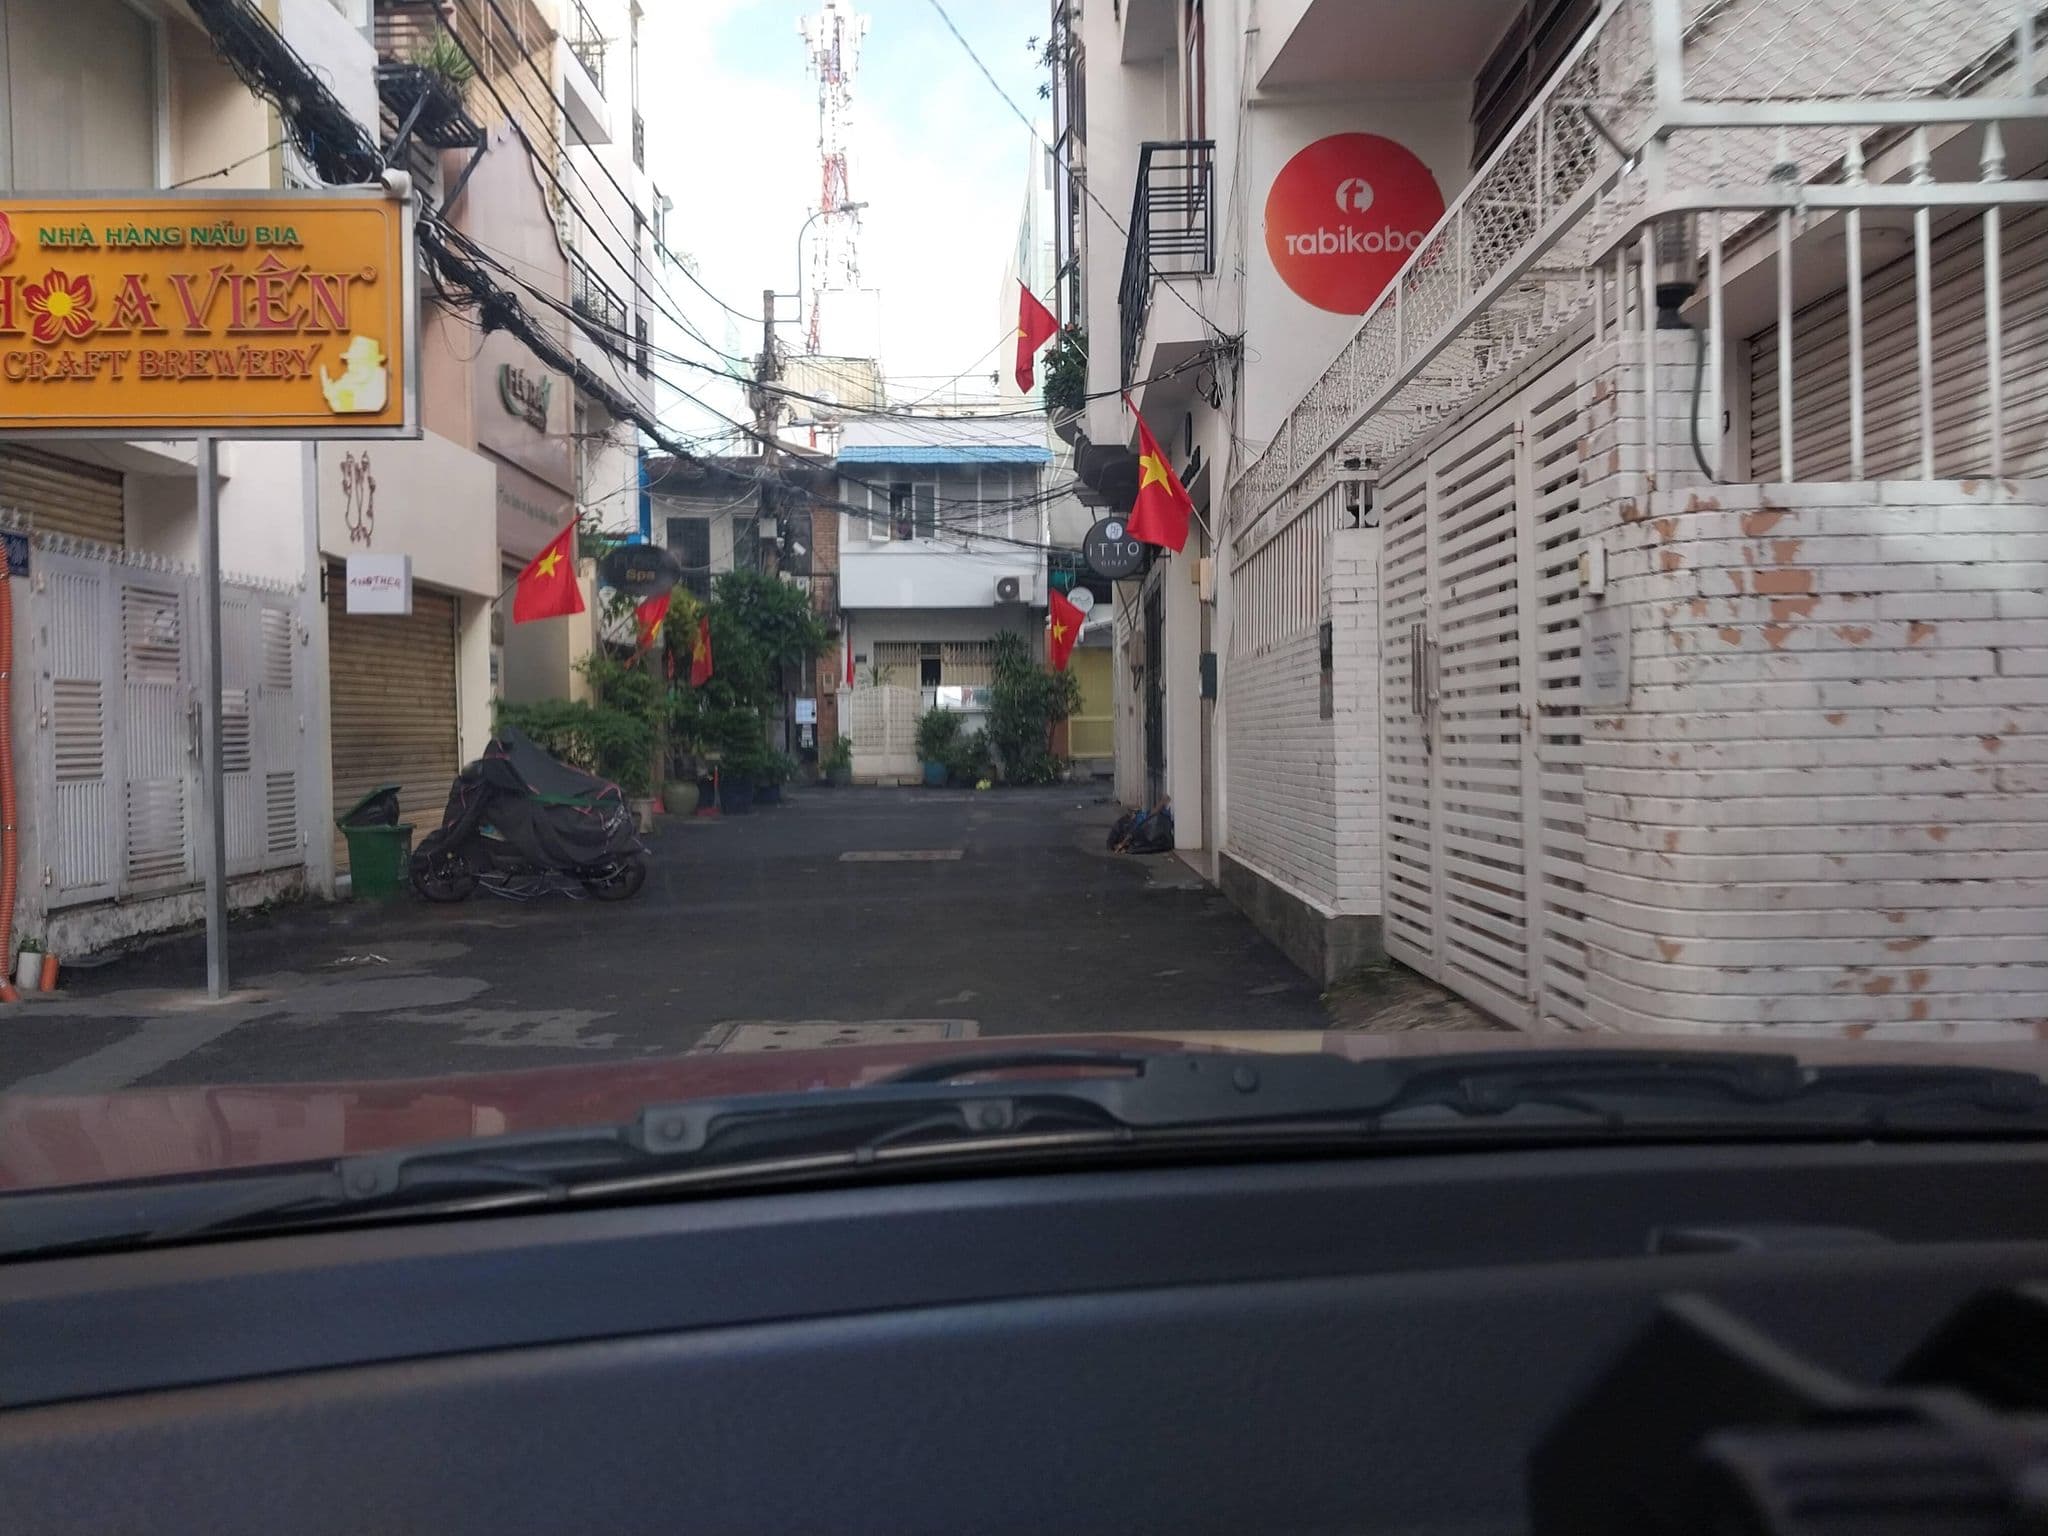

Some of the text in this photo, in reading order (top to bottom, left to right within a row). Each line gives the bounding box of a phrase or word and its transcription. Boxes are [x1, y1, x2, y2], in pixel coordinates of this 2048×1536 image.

[39, 222, 96, 245] NHÀ
[105, 222, 182, 246] HÀNG
[255, 226, 300, 245] BIA
[4, 343, 323, 381] CRAFT BREWERY
